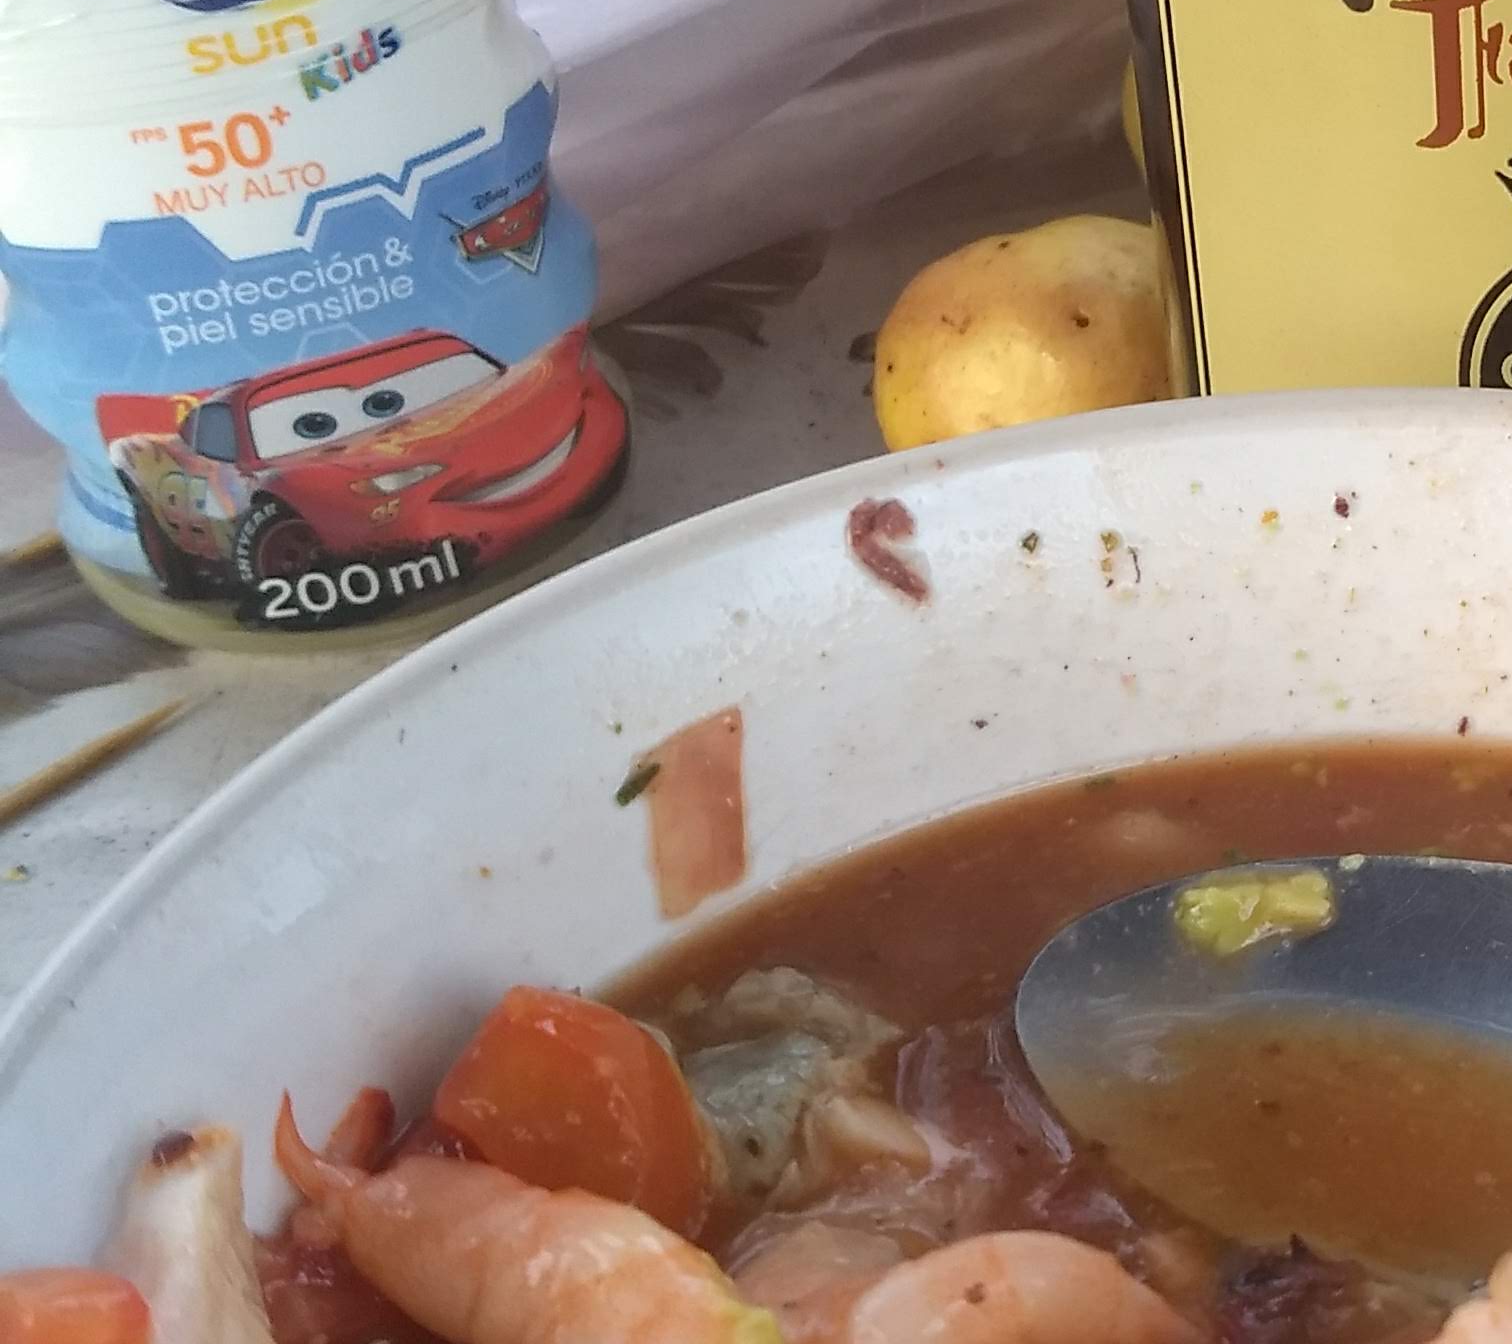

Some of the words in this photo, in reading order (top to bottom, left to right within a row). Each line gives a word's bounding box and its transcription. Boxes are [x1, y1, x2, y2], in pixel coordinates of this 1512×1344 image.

[298, 27, 402, 102] Kids
[129, 126, 168, 144] FPS
[153, 183, 230, 214] MUY
[243, 161, 326, 203] ALTO
[149, 251, 379, 322] protección
[384, 237, 414, 267] &
[159, 311, 238, 355] piel
[249, 275, 414, 337] sensible
[258, 563, 381, 619] 200
[388, 539, 461, 596] ml
